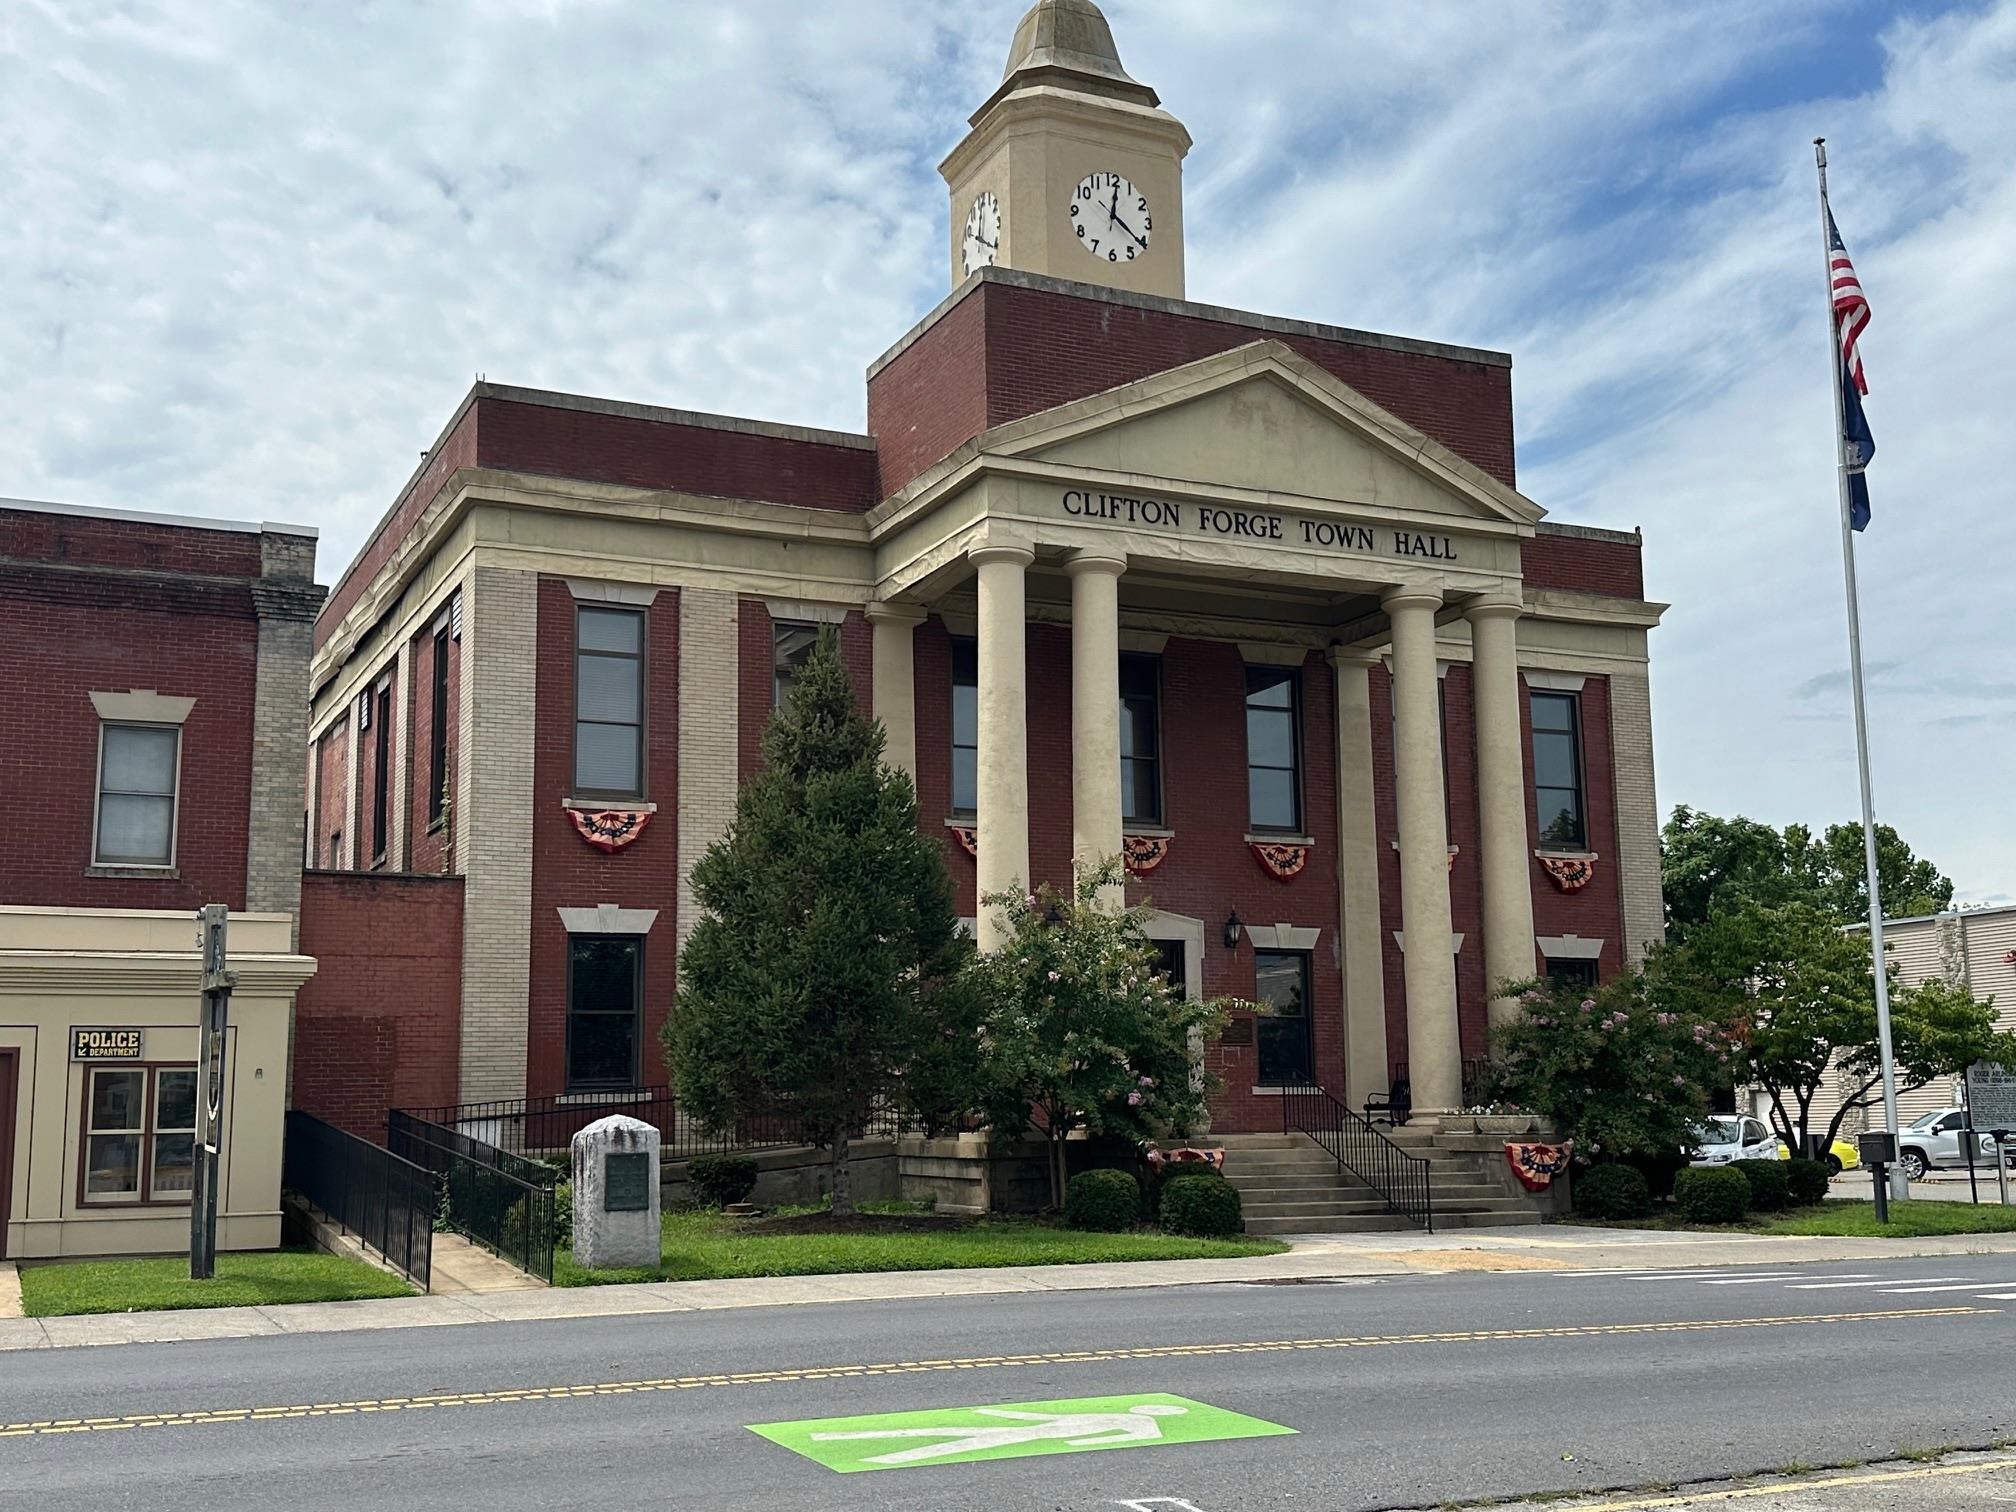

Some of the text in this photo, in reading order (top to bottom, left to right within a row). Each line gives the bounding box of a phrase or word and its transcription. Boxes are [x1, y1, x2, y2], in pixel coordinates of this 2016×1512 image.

[1090, 174, 1099, 190] 11
[1106, 172, 1120, 188] 12
[1077, 184, 1091, 200] 10
[1127, 181, 1132, 195] 1
[993, 198, 998, 214] 2
[1070, 205, 1079, 217] 9
[1138, 197, 1147, 211] 2
[1144, 217, 1152, 230] 3
[1076, 224, 1085, 238] 8
[1091, 239, 1100, 253] 7
[1126, 246, 1135, 260] 5
[1108, 249, 1117, 262] 6
[1062, 490, 1458, 560] CLIFTON FORGE TOWN HALL
[78, 1032, 139, 1047] POLICE
[89, 1047, 139, 1056] DEPARTMENT
